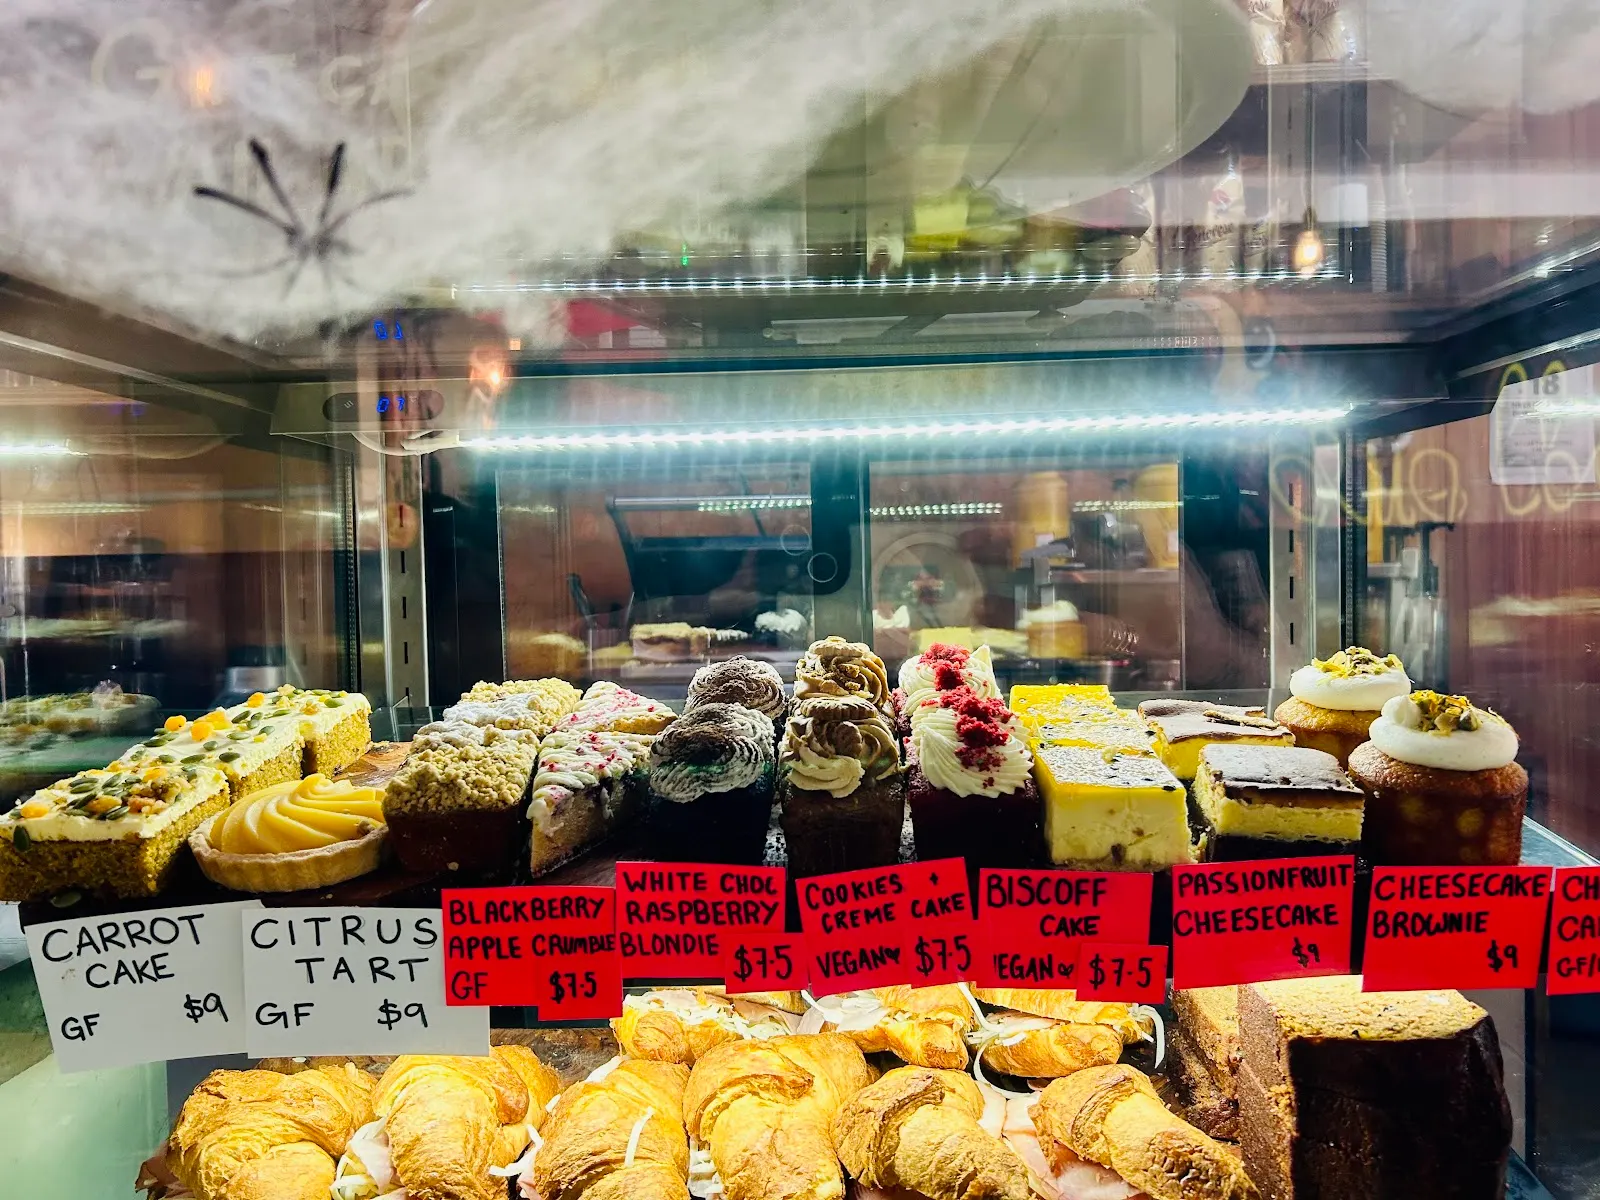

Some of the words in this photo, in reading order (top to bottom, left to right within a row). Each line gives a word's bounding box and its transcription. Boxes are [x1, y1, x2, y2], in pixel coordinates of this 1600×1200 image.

[624, 872, 706, 892] WHITE
[720, 873, 776, 895] CHOC
[804, 873, 902, 911] COOKIES
[988, 874, 1106, 908] BISCOFF
[1179, 864, 1352, 897] PASSIONFRUIT
[1375, 873, 1546, 900] CHEESECAKE
[450, 896, 604, 925] BLACKBERRY
[626, 900, 778, 925] RASPBERRY
[821, 903, 896, 934] CREME
[911, 893, 964, 918] CAKE
[1173, 904, 1338, 936] CHEESECAKE
[1373, 910, 1488, 938] BROWNIE
[41, 914, 205, 963] CARROT
[251, 915, 437, 949] CITRUS
[1040, 915, 1100, 937] CAKE
[1558, 915, 1600, 941] CA
[450, 936, 521, 959] APPLE
[532, 934, 615, 956] CRUMBLE
[620, 932, 718, 957] BLONDIE
[1292, 938, 1319, 967] $9
[1488, 940, 1517, 972] $9
[86, 952, 174, 988] CAKE
[295, 957, 429, 984] TART
[817, 946, 883, 978] VEGAN
[1557, 954, 1600, 977] GF/
[452, 971, 487, 999] GF
[61, 1013, 99, 1041] GF
[184, 993, 228, 1023] $9
[256, 1003, 314, 1028] GF
[378, 999, 428, 1030] $9
